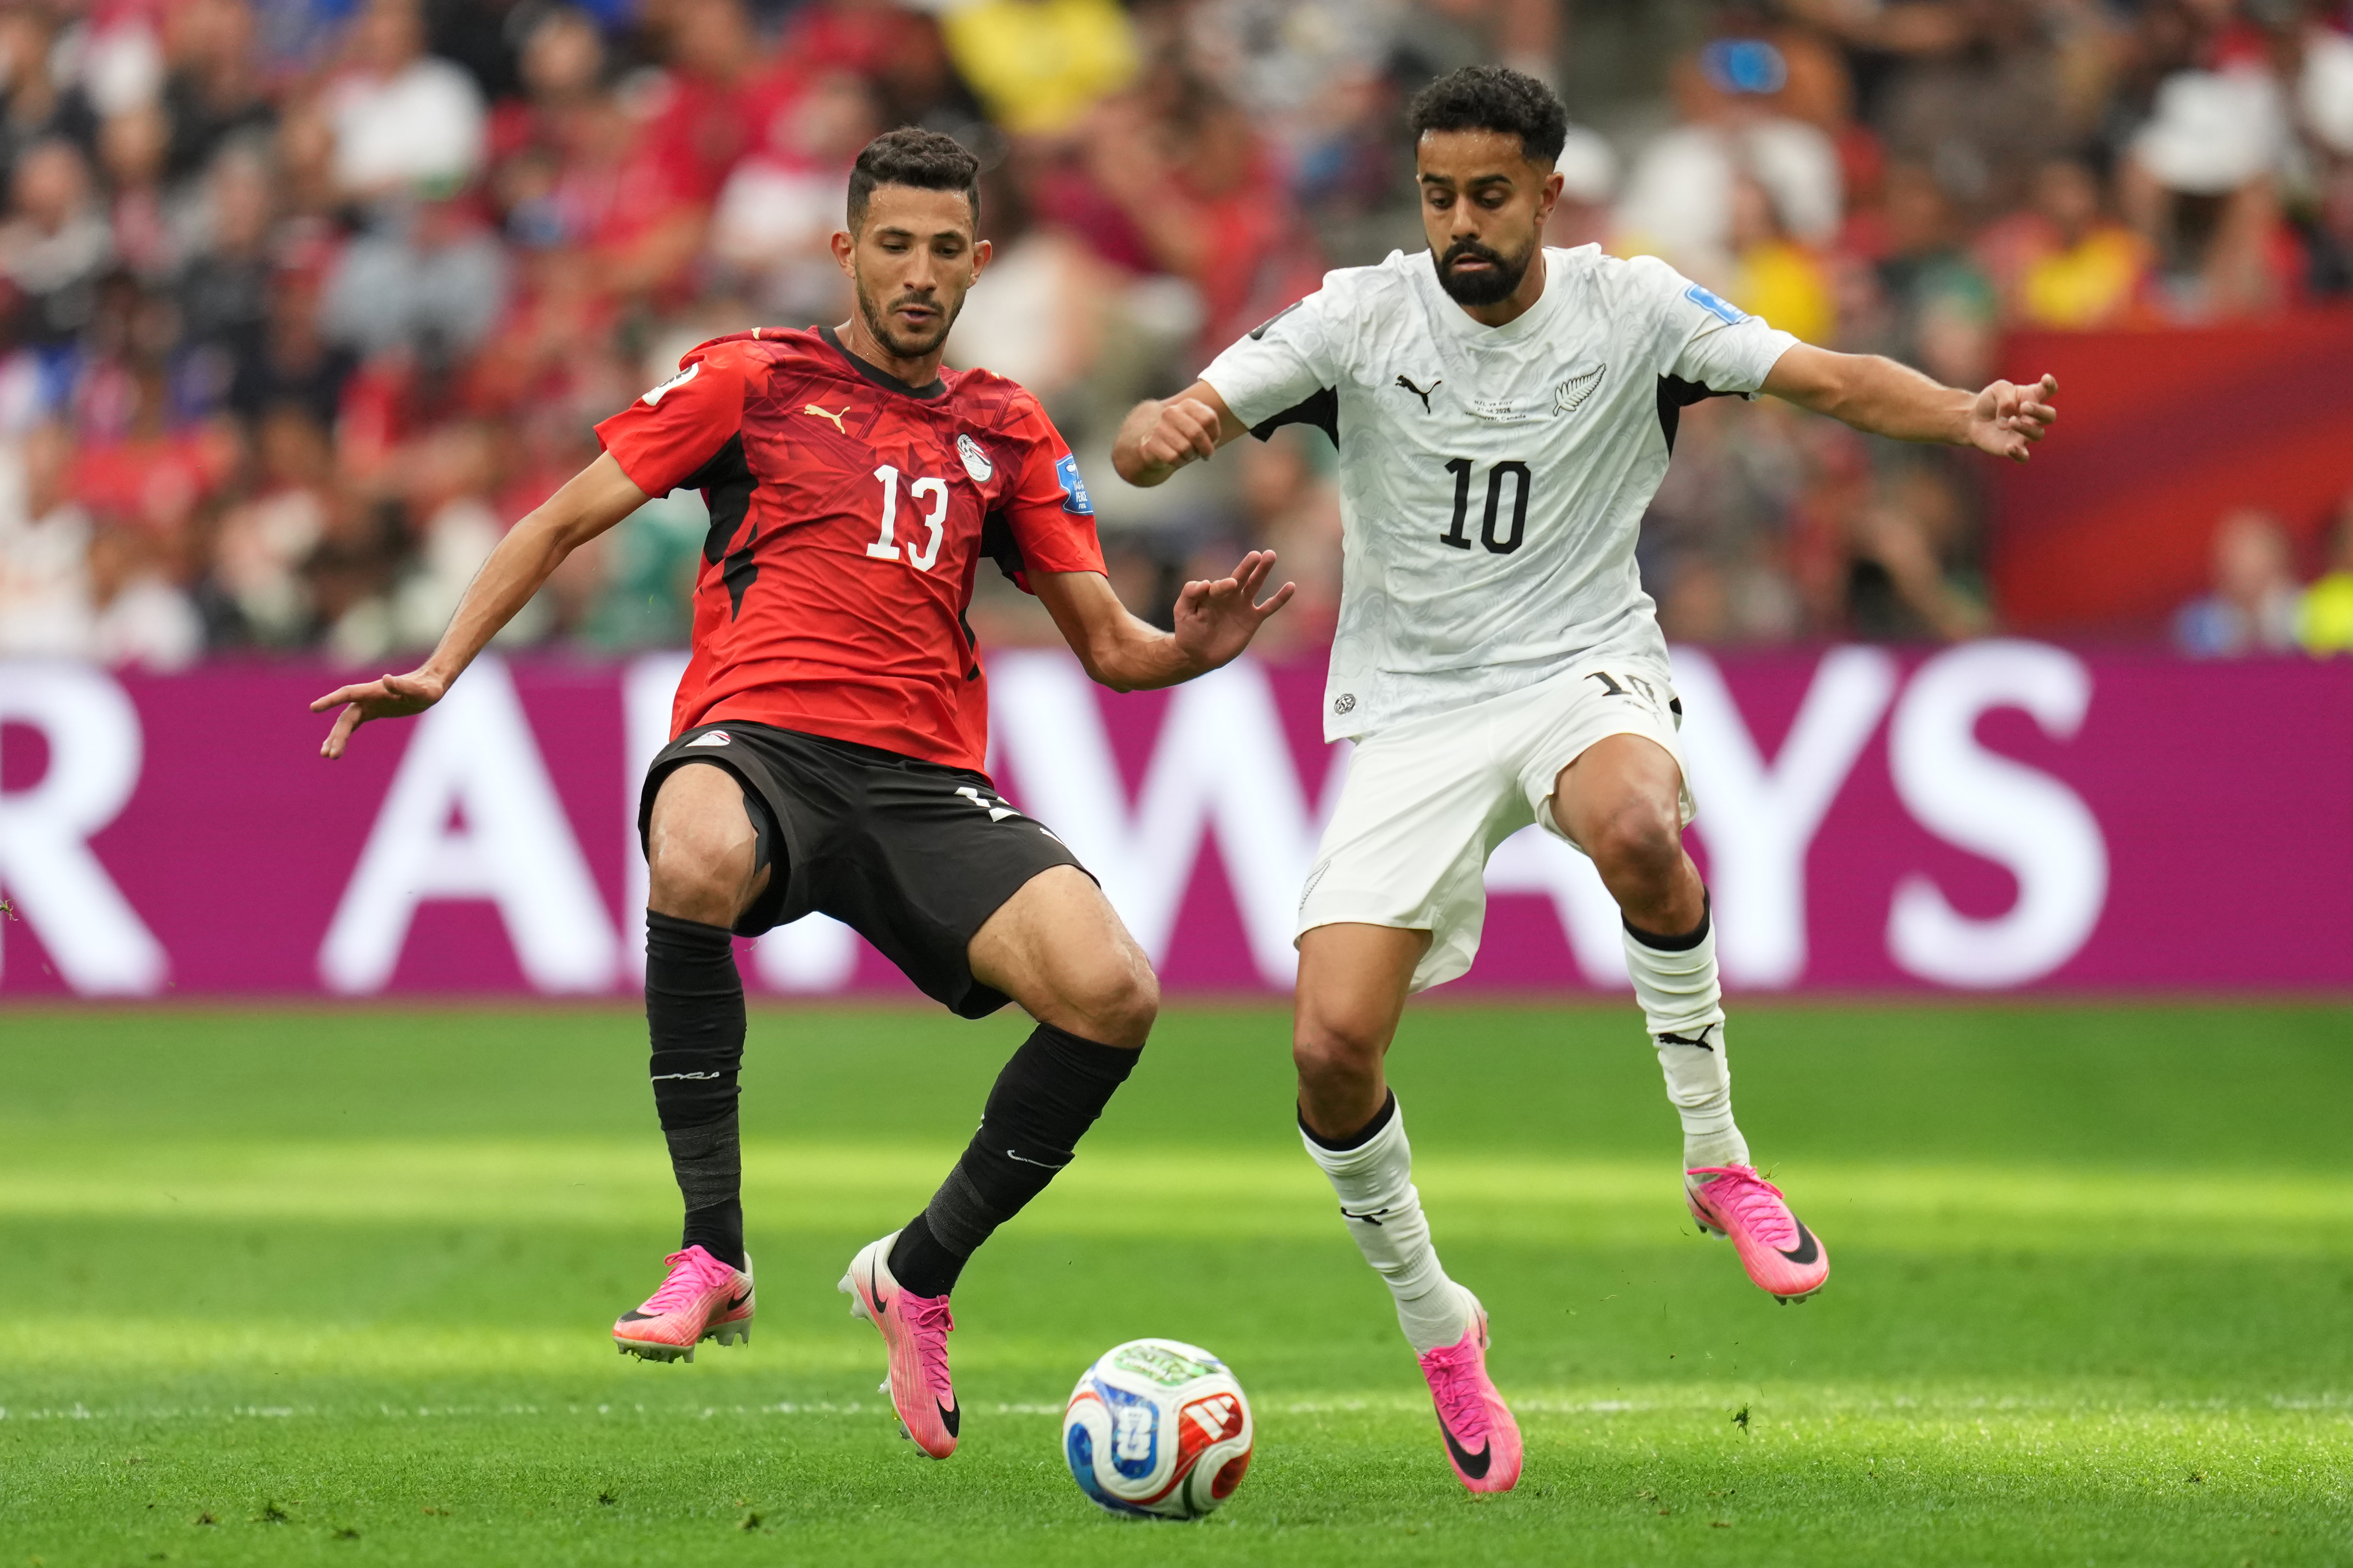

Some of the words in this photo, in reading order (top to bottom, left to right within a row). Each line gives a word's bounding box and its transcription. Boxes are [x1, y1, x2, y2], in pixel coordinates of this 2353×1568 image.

[1501, 412, 1526, 421] Canada
[866, 464, 948, 572] 13
[1440, 458, 1531, 554] 10
